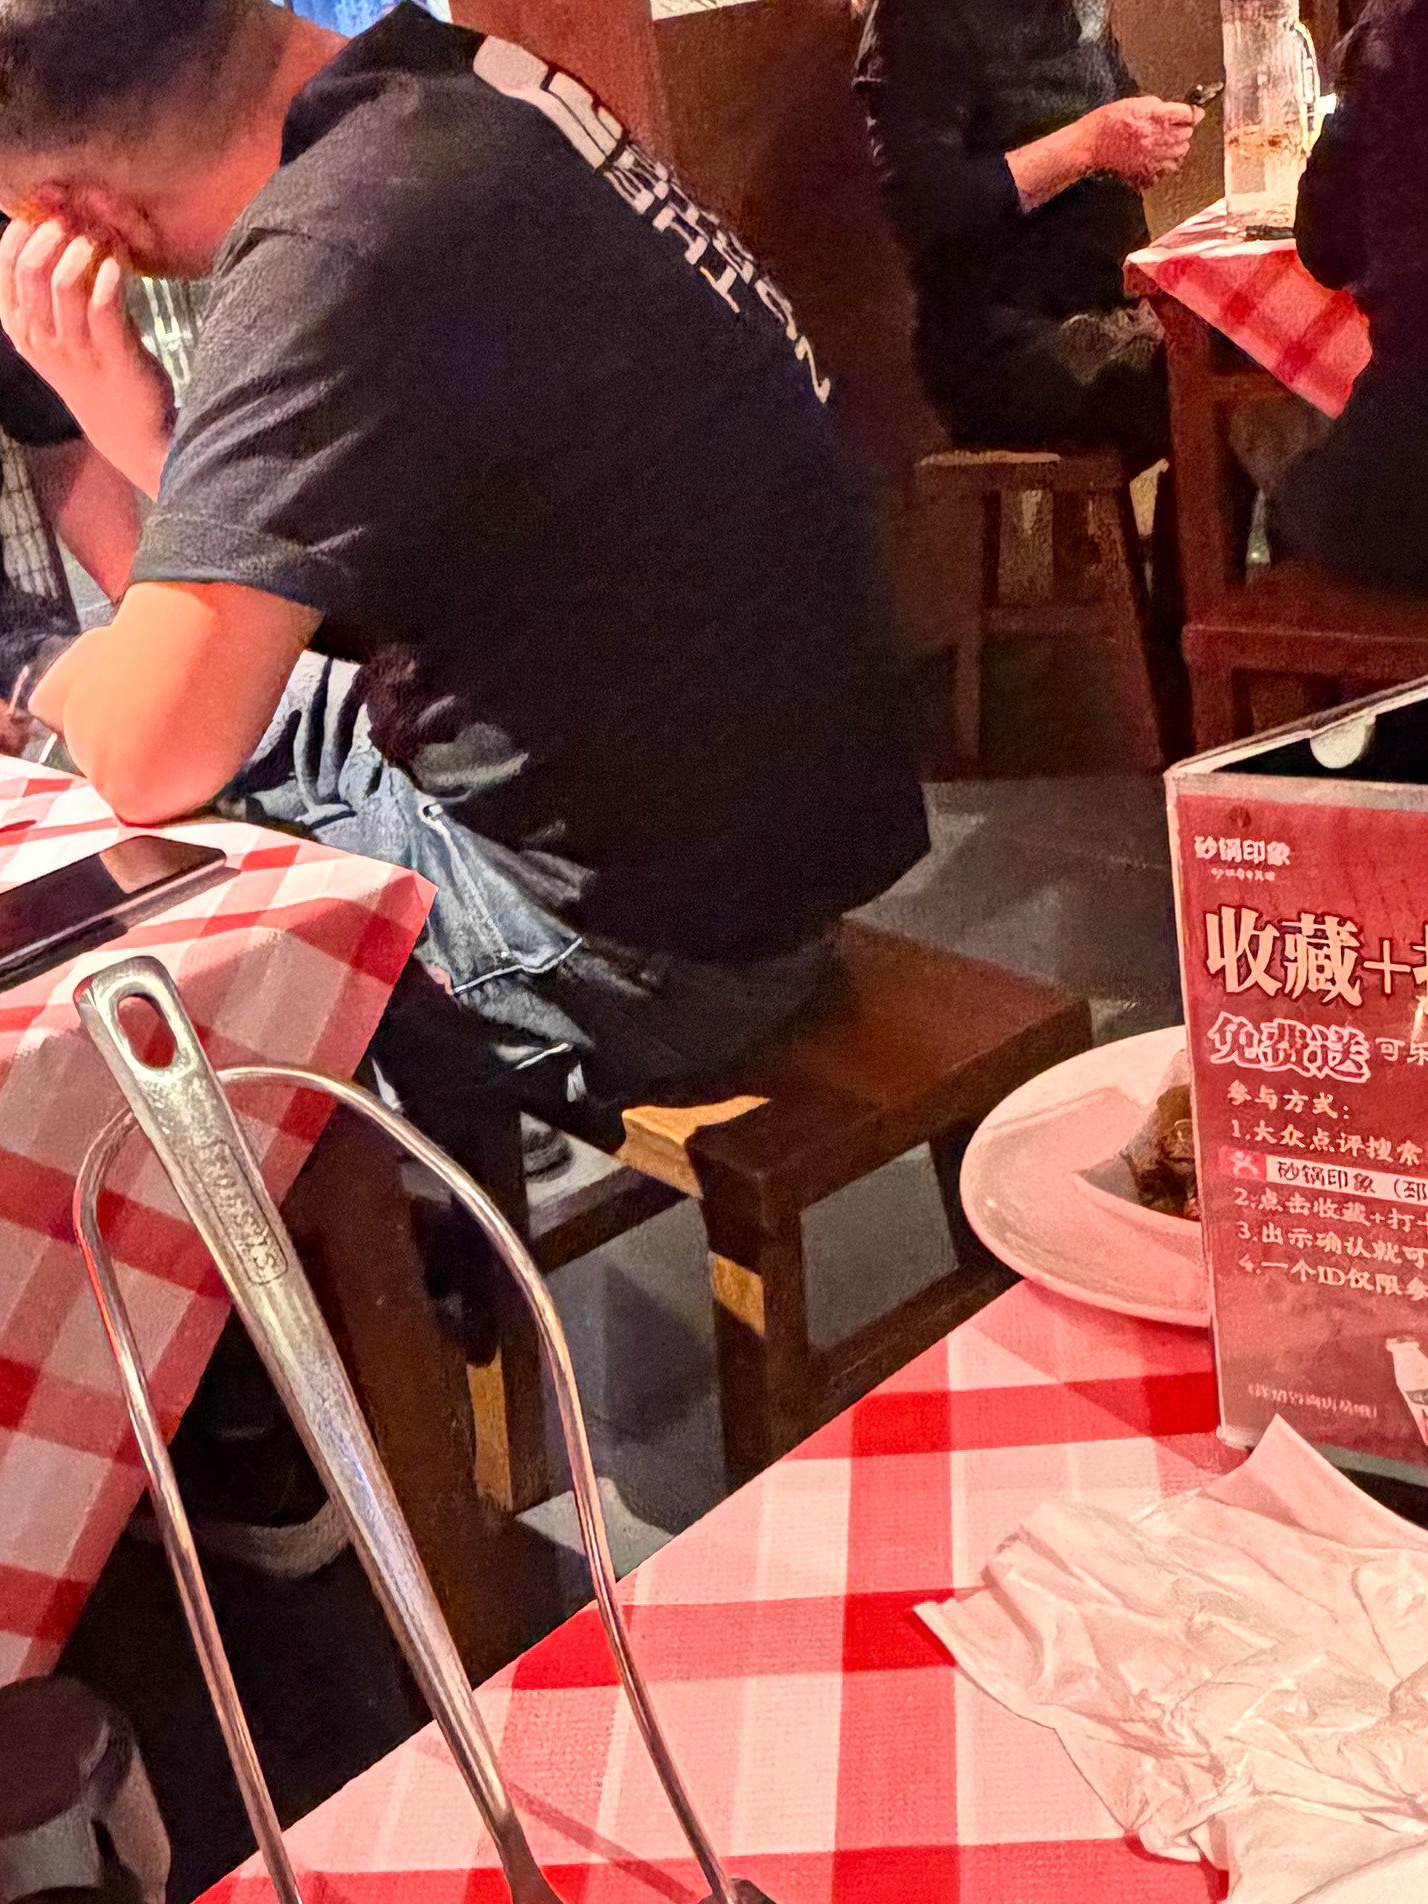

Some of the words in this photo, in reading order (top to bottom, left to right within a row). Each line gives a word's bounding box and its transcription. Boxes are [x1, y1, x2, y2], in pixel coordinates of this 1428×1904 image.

[603, 166, 740, 313] THE
[1194, 835, 1291, 866] 砂锅印象
[1207, 1011, 1372, 1083] 免费送
